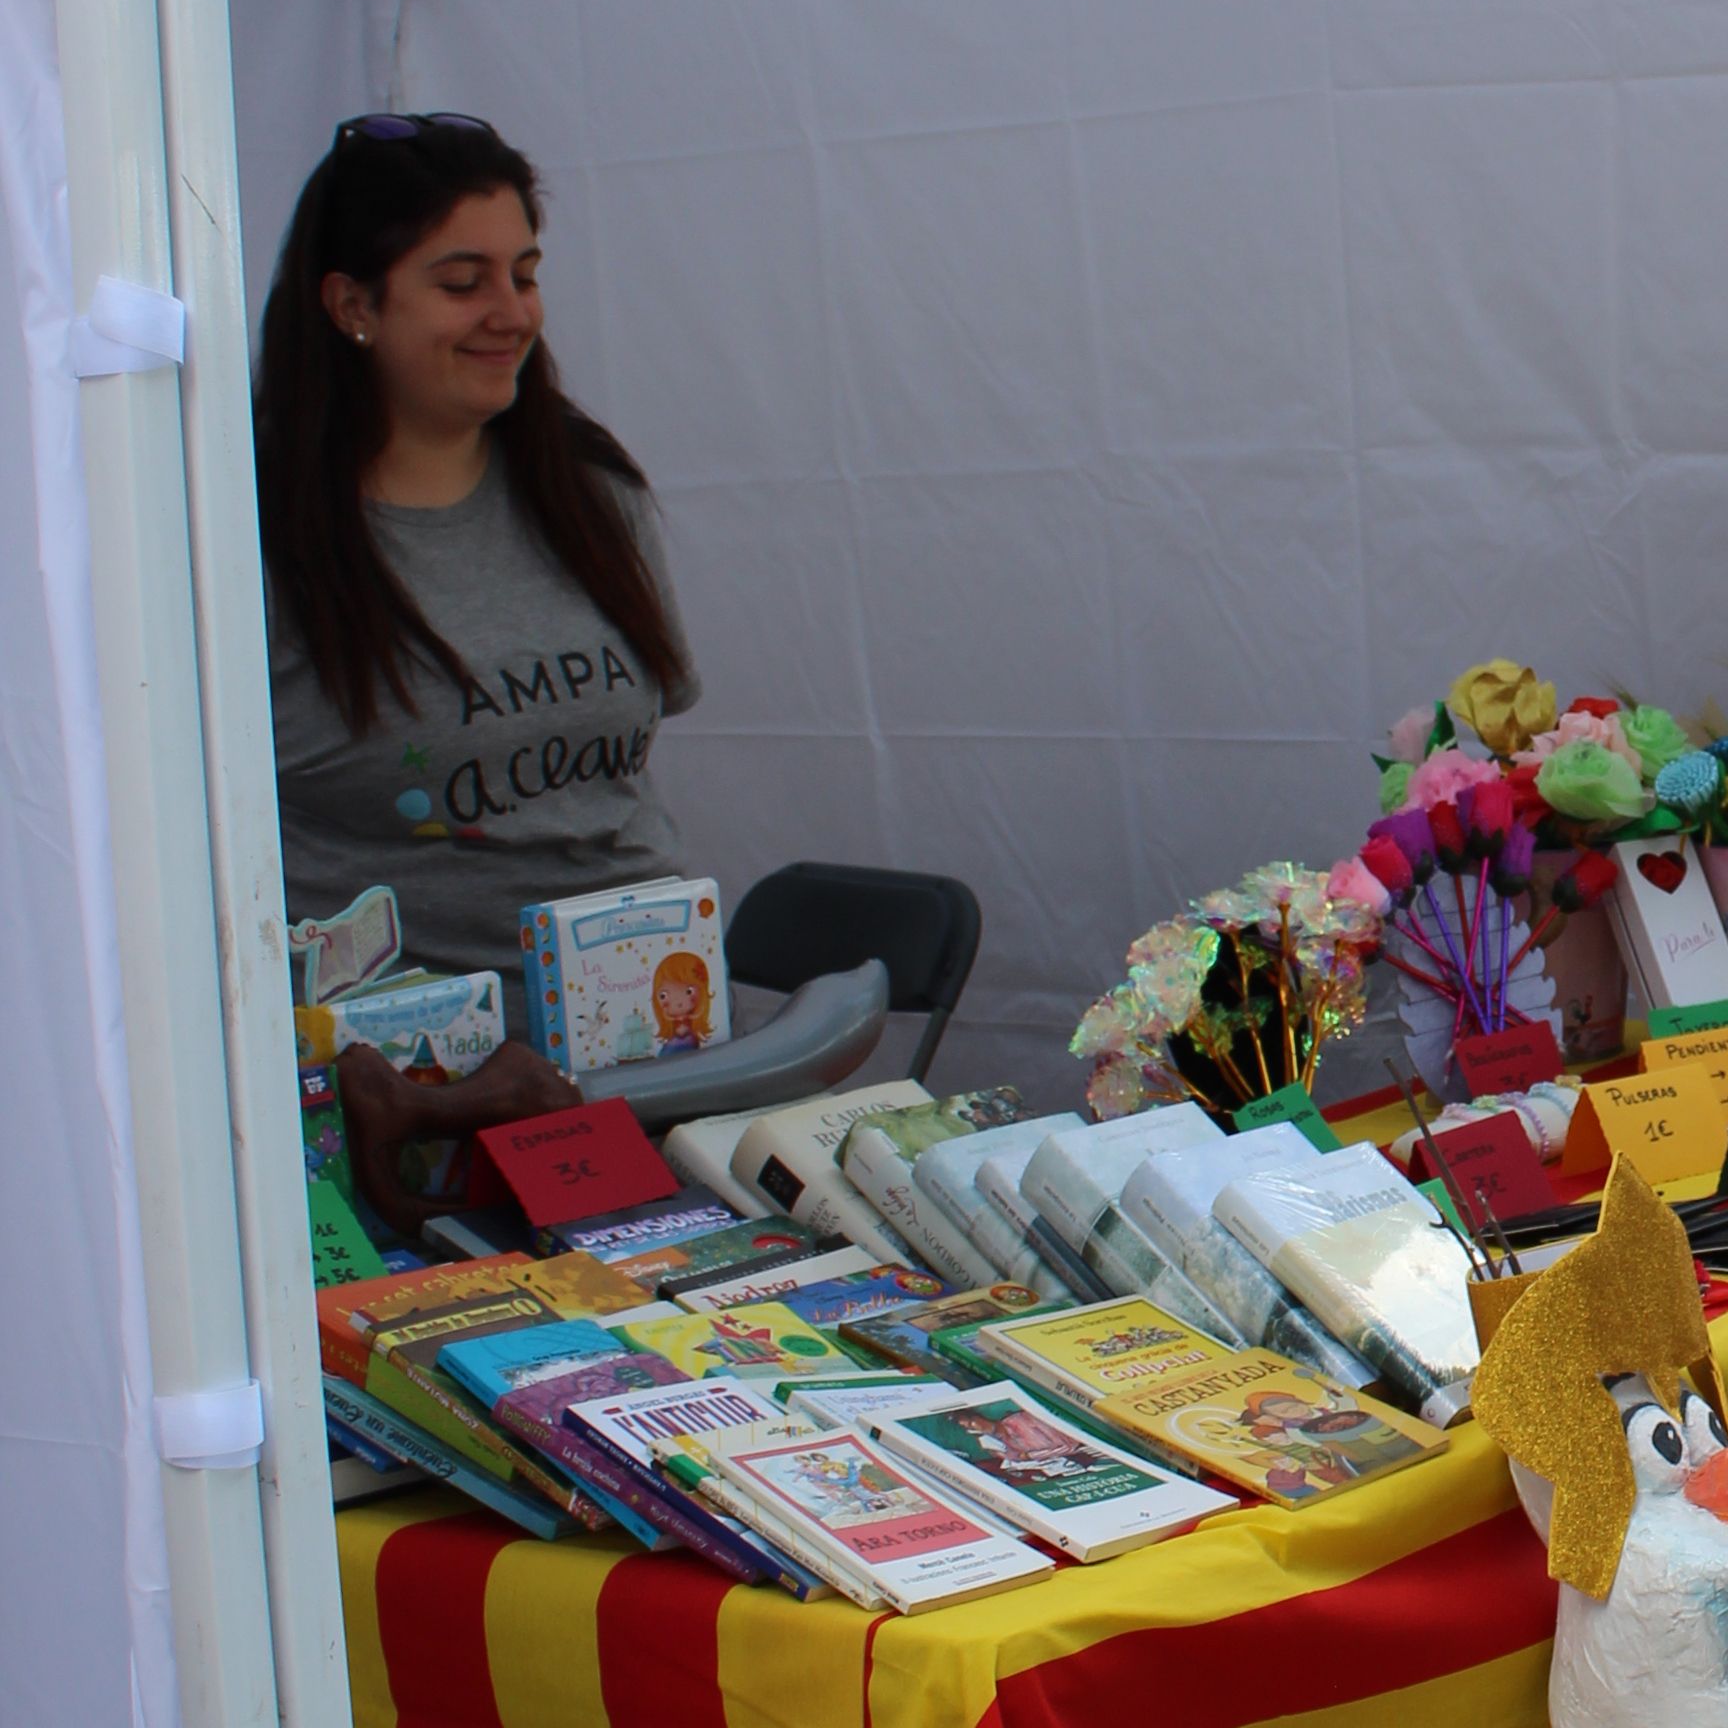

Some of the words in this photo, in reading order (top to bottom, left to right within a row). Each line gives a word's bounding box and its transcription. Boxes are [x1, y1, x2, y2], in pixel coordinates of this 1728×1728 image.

[462, 644, 637, 725] AMPA
[1644, 1120, 1674, 1142] 1€
[551, 1159, 600, 1186] 3€
[573, 1205, 732, 1247] DIMENSIONES
[1133, 1358, 1287, 1417] CASTANYADA
